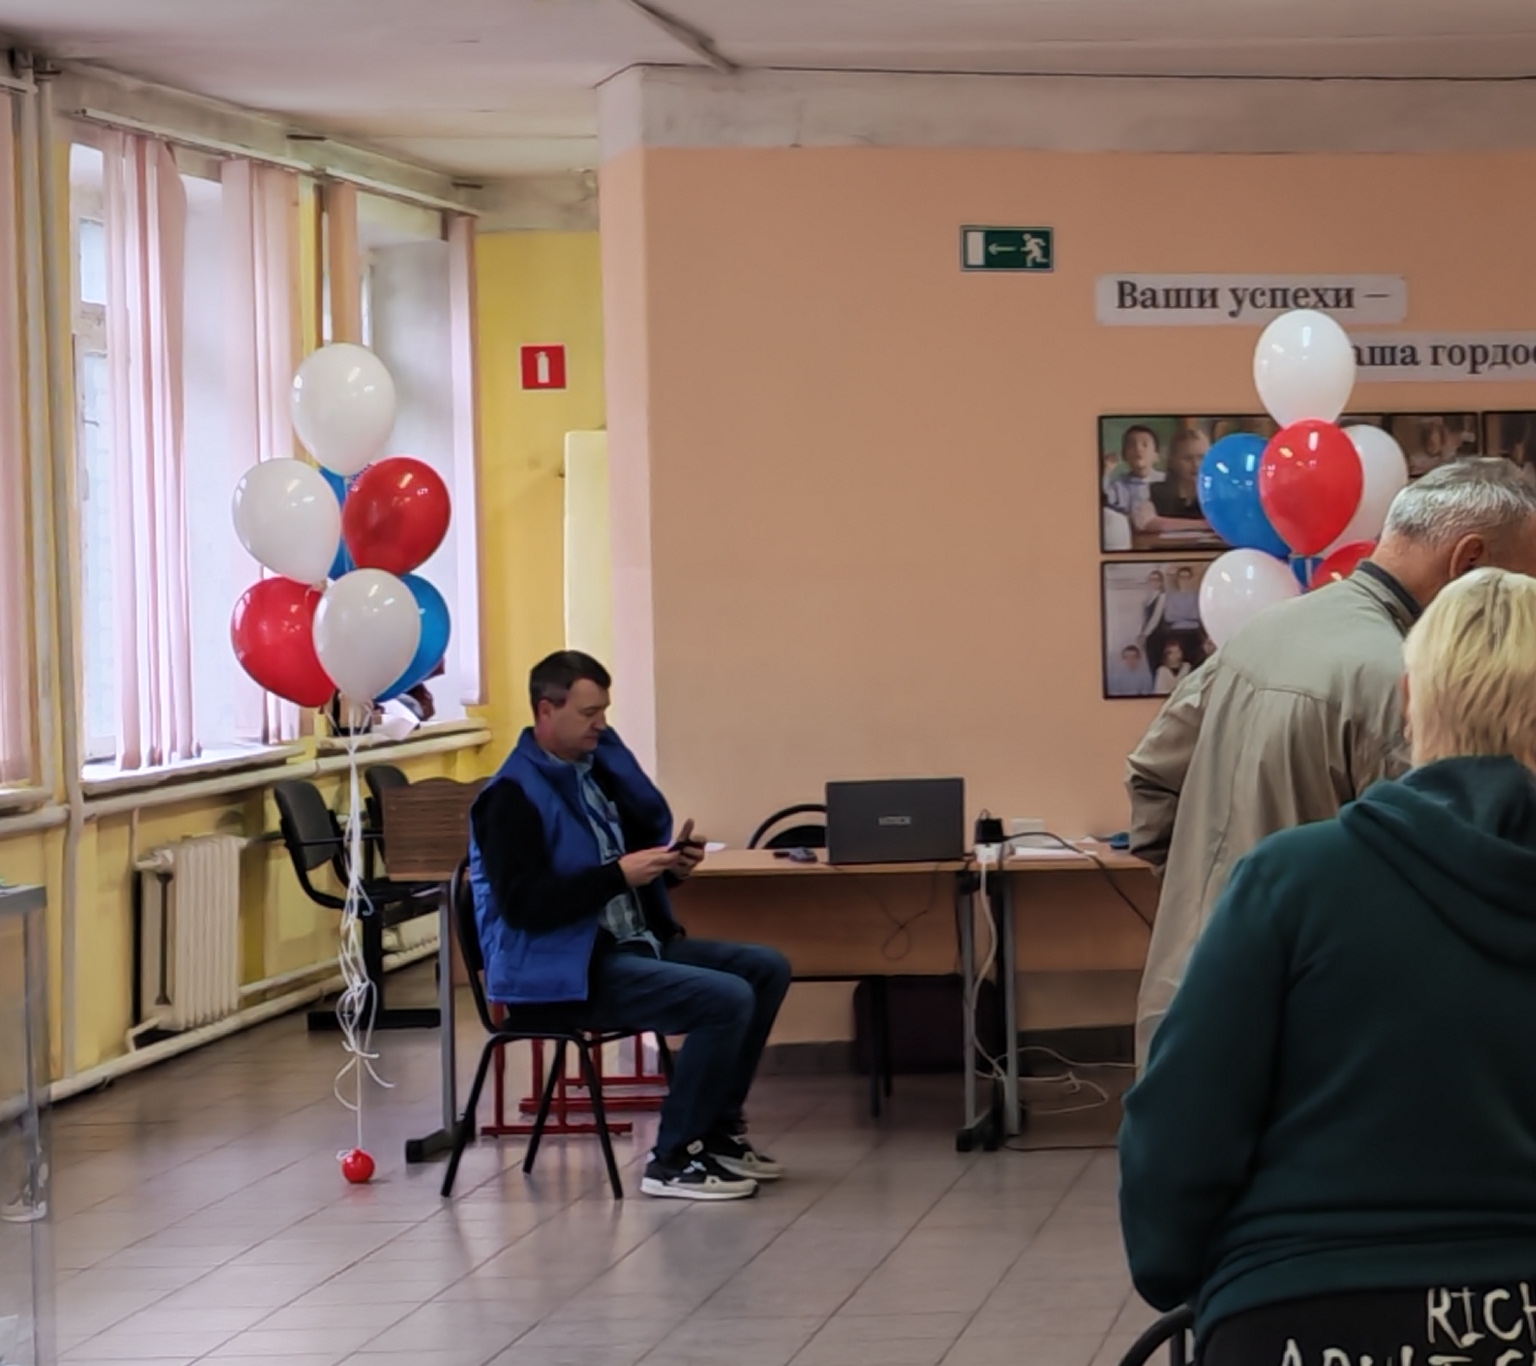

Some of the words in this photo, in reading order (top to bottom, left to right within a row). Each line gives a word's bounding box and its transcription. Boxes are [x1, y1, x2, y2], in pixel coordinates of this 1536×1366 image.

[1115, 280, 1219, 310] Ваши
[1228, 286, 1355, 318] успехи
[1351, 344, 1421, 367] аша
